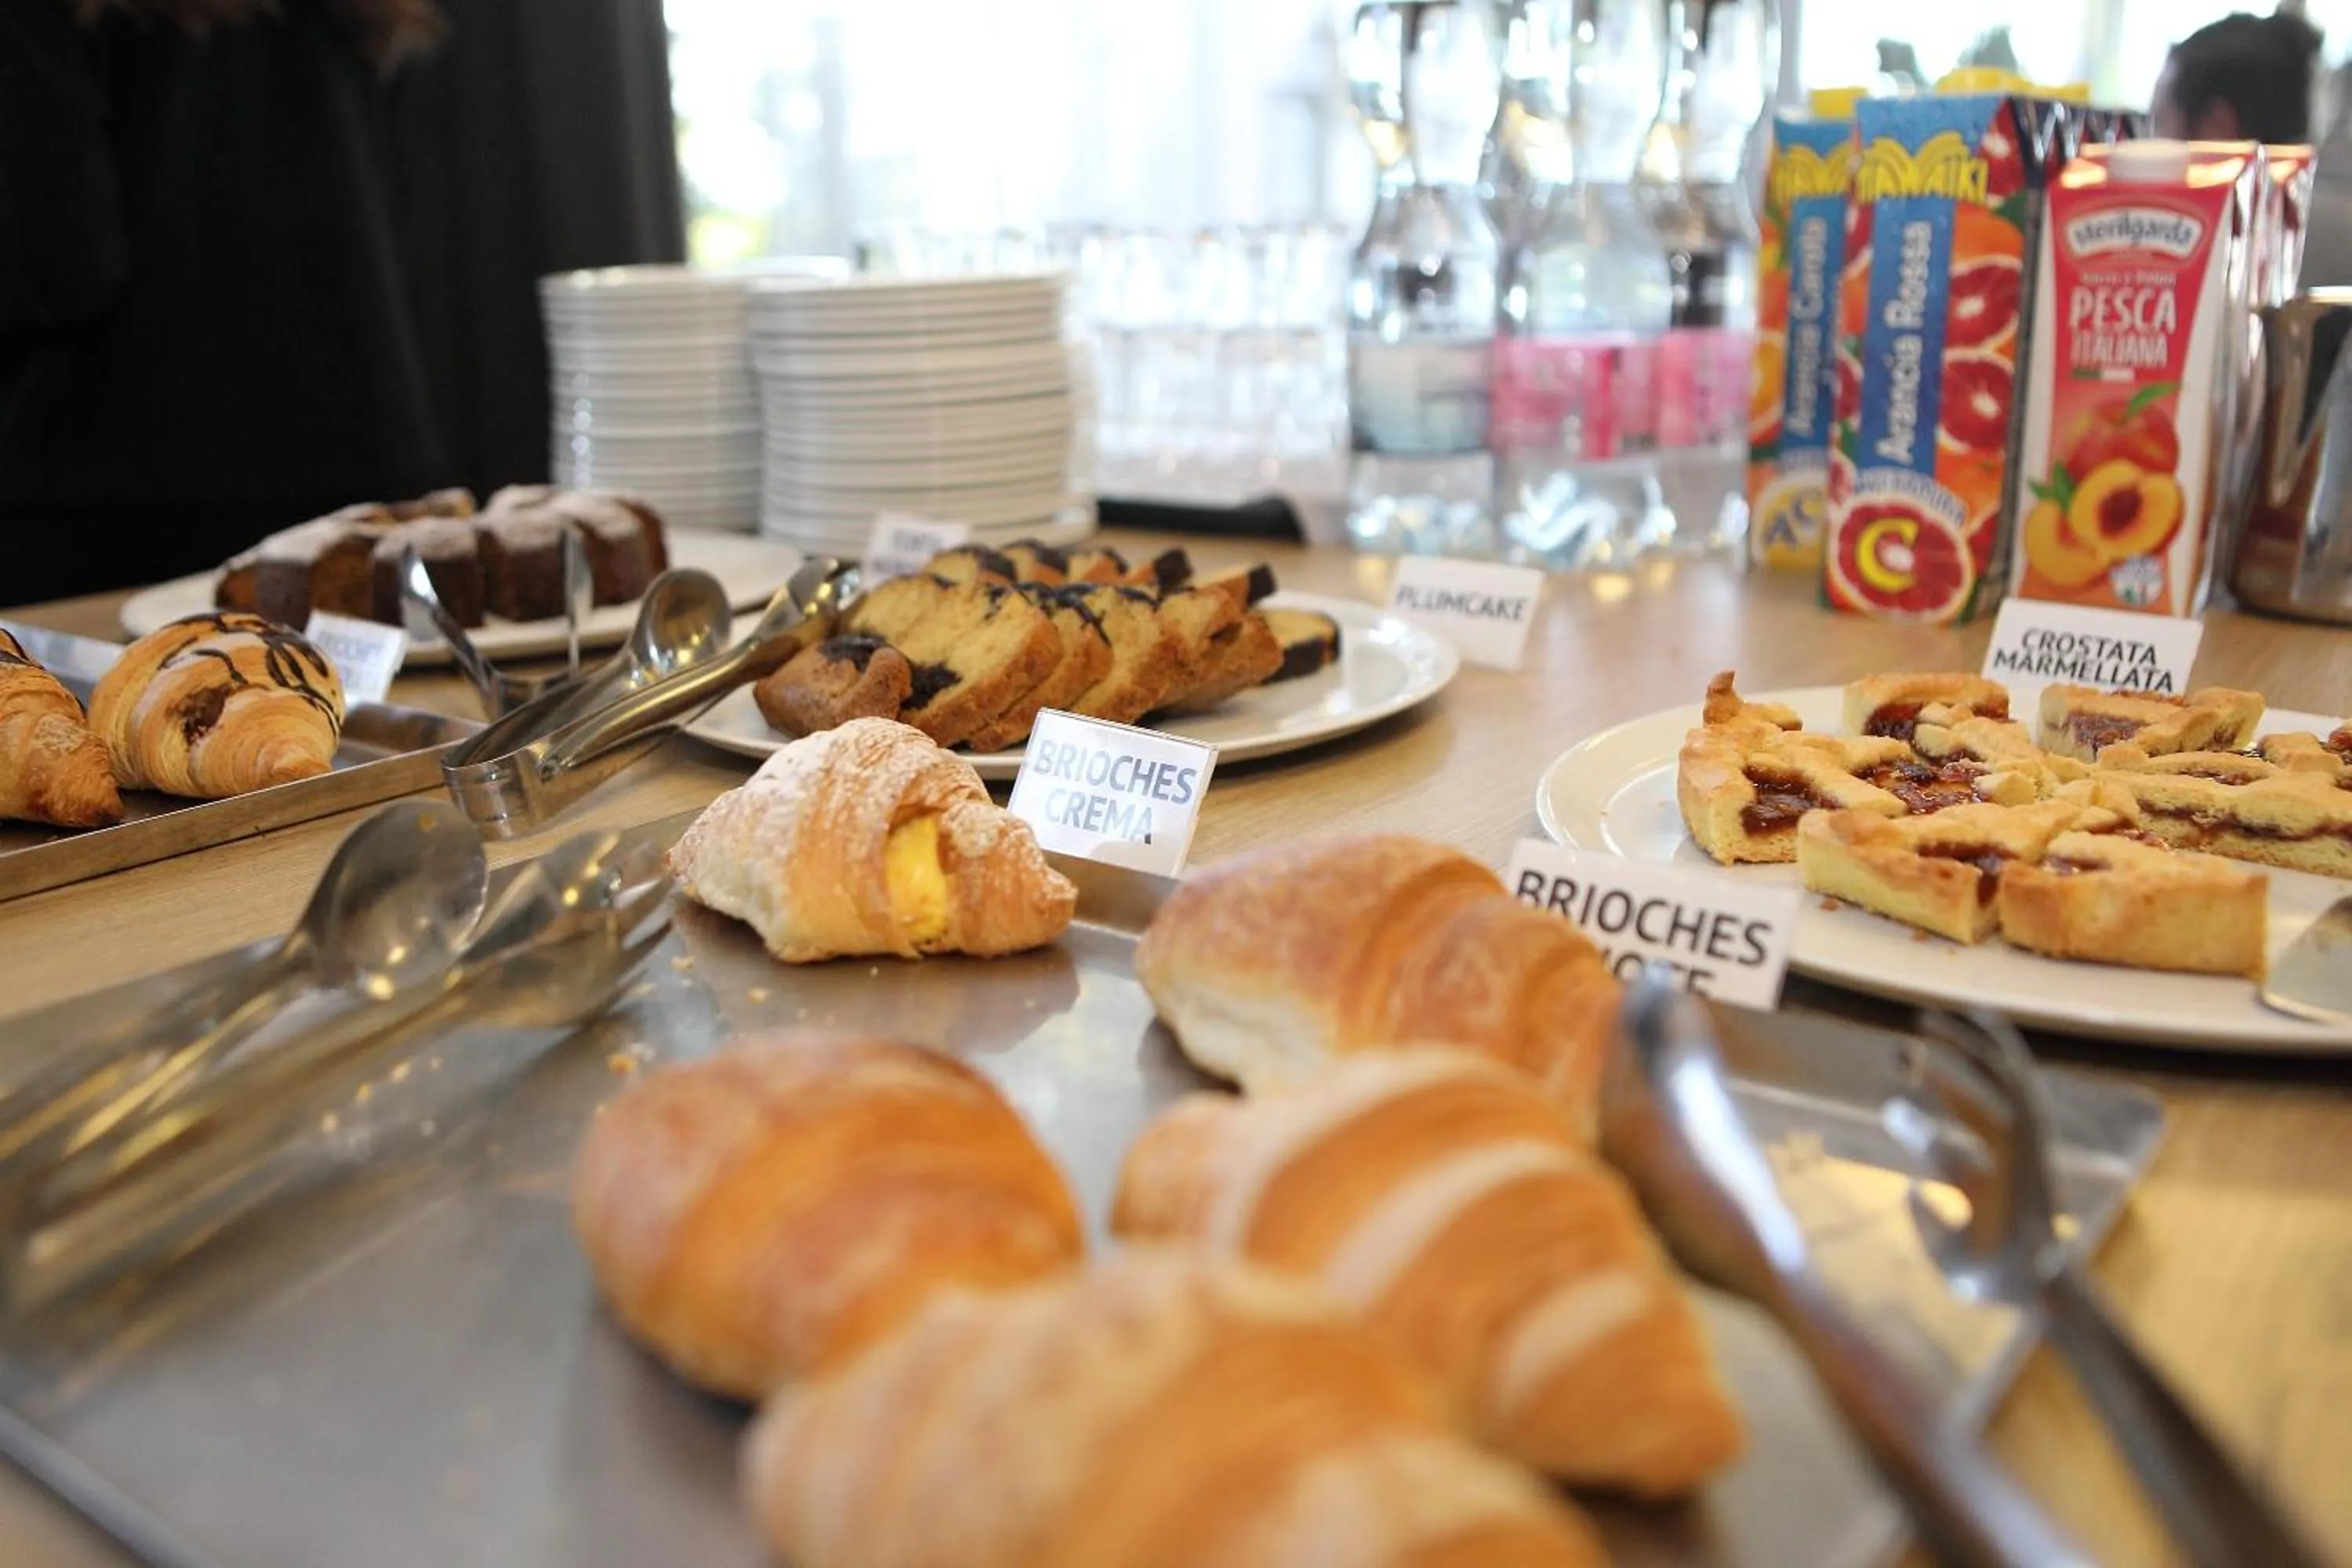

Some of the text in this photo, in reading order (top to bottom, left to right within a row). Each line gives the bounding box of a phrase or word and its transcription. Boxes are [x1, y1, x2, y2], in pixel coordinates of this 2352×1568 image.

[1884, 221, 1932, 328] Rossa
[2070, 285, 2177, 336] PESCA
[2070, 330, 2169, 368] ITALIANA
[1875, 334, 1923, 466] Arancia
[1394, 583, 1530, 621] PLUMCAKE
[1993, 648, 2173, 692] MARMELLATA
[2021, 628, 2158, 666] CROSTATA
[1033, 739, 1196, 805] BRIOCHES
[1045, 788, 1152, 845] CREMA
[1516, 869, 1774, 968] BRIOCHES
